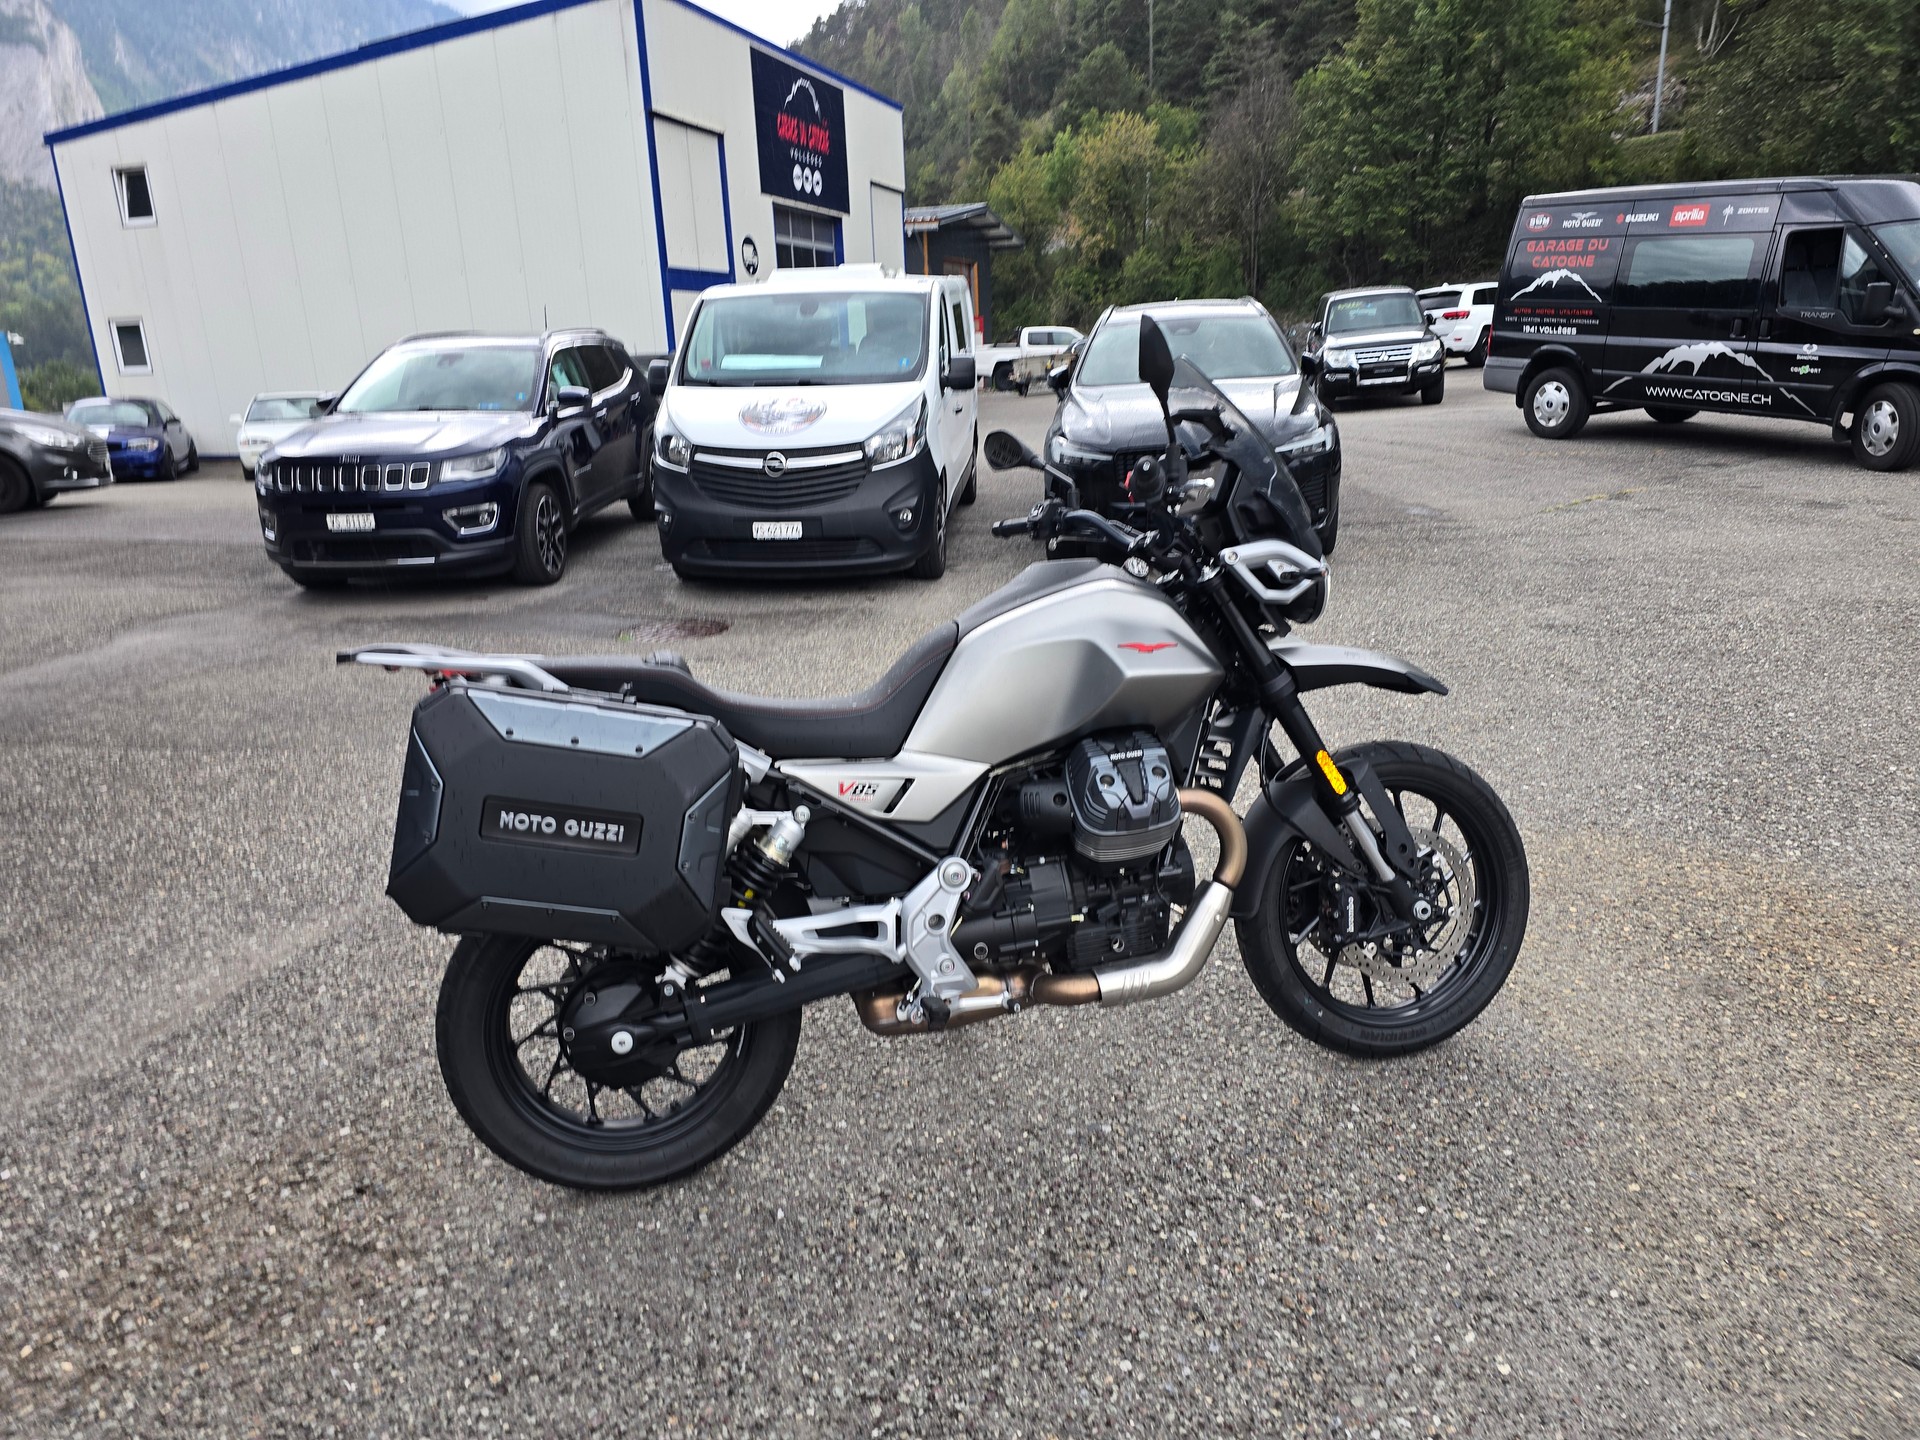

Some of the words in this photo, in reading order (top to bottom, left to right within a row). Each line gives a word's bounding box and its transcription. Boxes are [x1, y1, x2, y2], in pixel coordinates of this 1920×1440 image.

[1674, 208, 1704, 223] aprilia
[1737, 206, 1769, 215] ZONTES
[1625, 213, 1659, 223] SUZUKI
[1562, 220, 1580, 229] MOTO
[1581, 219, 1603, 228] GUZZI
[1526, 239, 1584, 252] GARAGE
[1587, 238, 1610, 251] DU
[1532, 255, 1596, 268] CATOGNE
[1800, 311, 1836, 319] TRANSIT
[1522, 325, 1538, 334] 1941
[1645, 385, 1772, 406] WWW.CATOGNE.CH
[499, 810, 557, 834] MOTO
[564, 819, 625, 842] GUZZI
